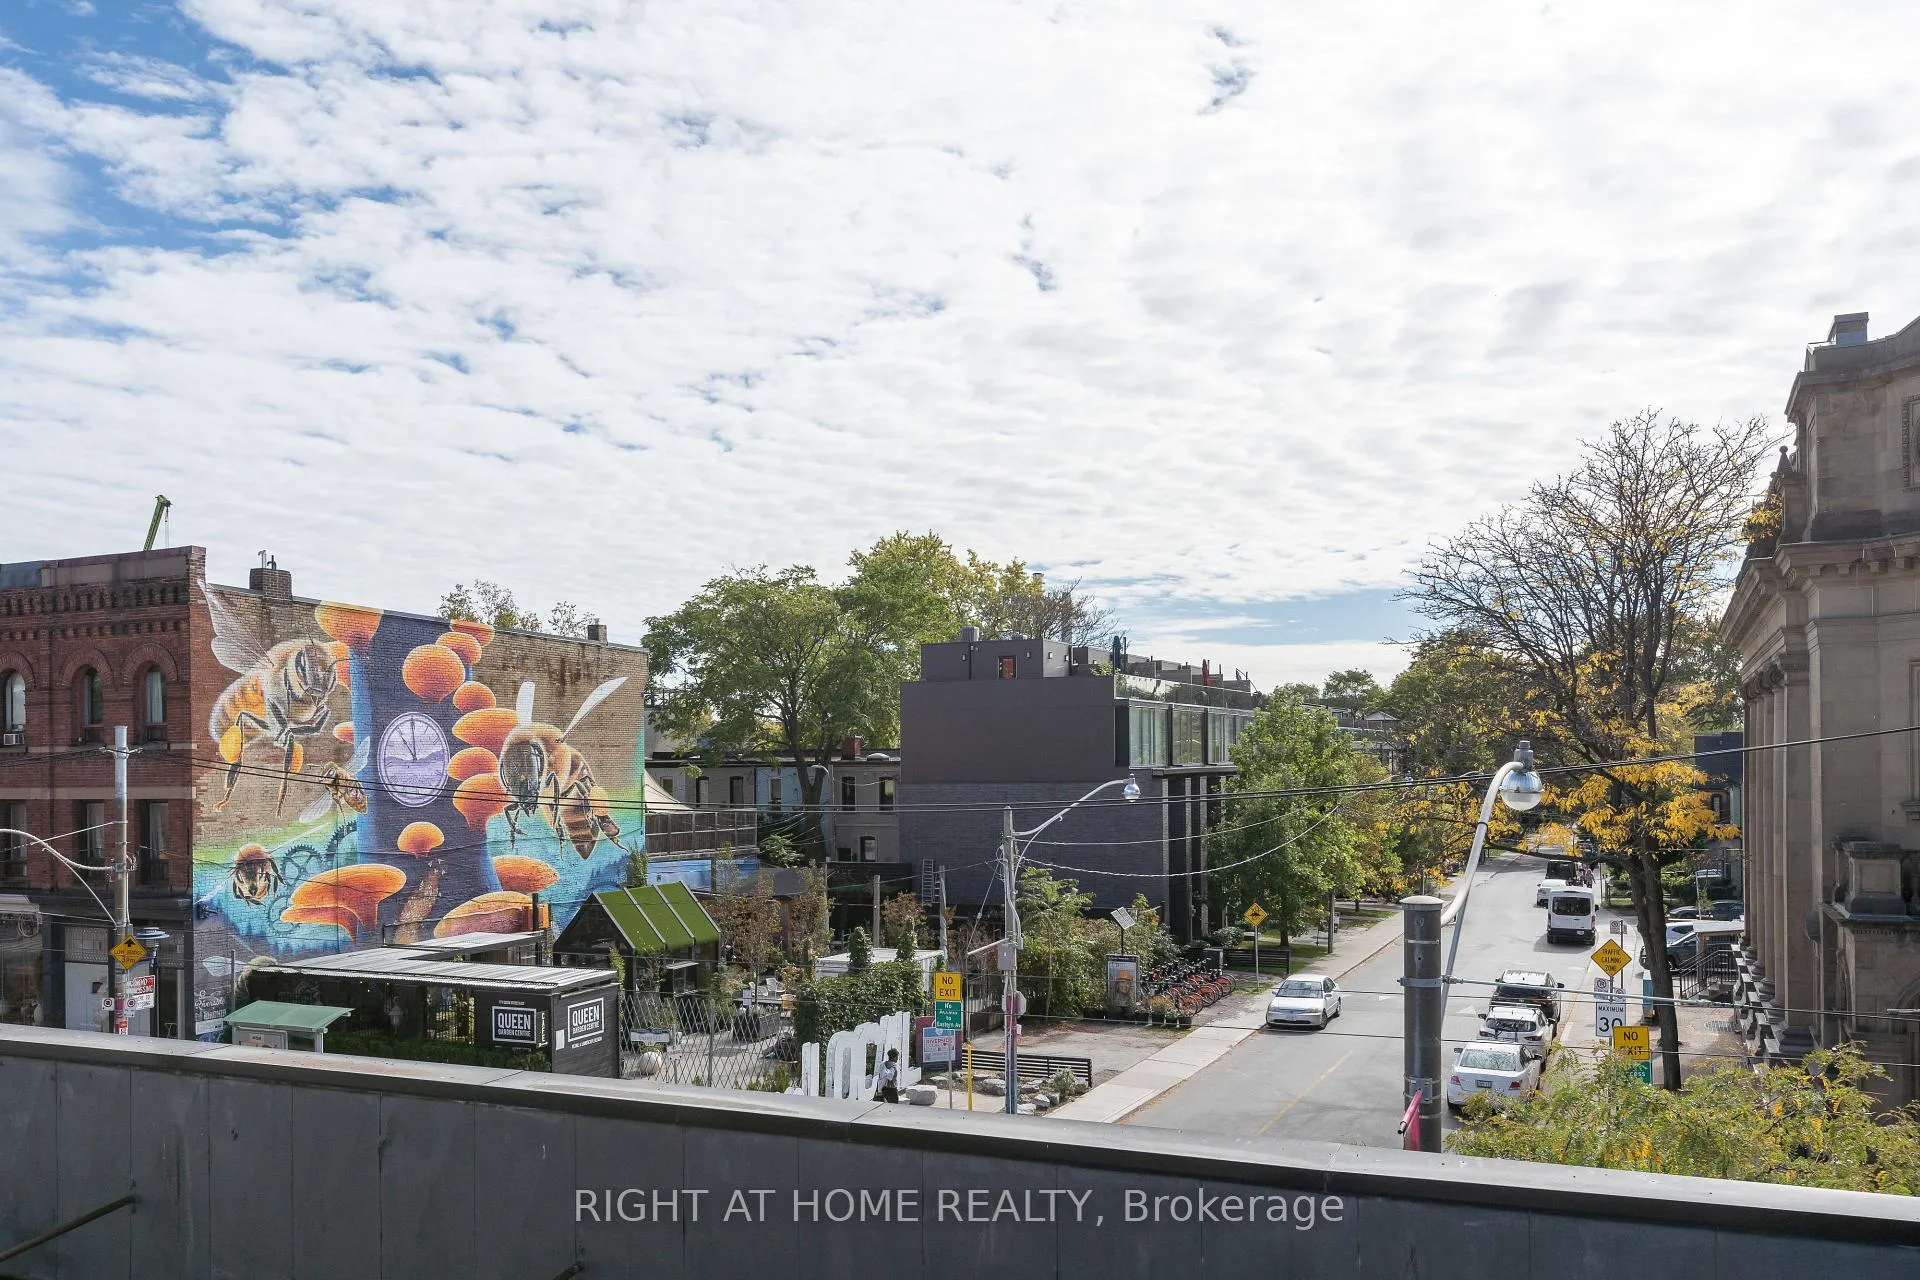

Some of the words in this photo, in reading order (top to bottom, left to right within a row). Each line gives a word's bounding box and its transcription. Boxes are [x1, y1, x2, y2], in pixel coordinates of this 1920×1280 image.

[942, 976, 954, 985] NO
[939, 988, 957, 997] EXIT
[572, 1005, 600, 1026] QUEEN
[497, 1012, 531, 1030] QUEEN
[1623, 1031, 1639, 1041] NO
